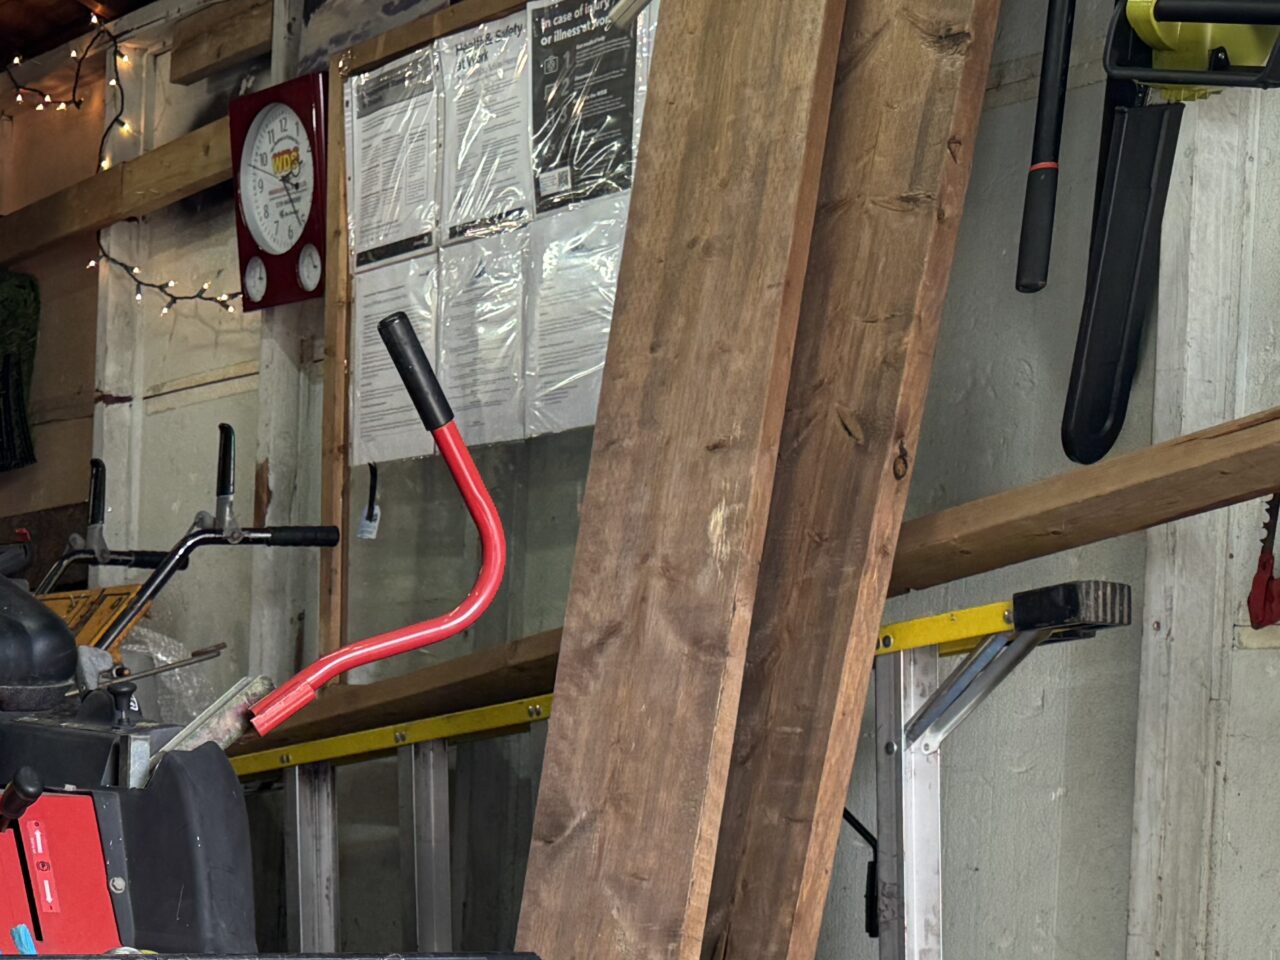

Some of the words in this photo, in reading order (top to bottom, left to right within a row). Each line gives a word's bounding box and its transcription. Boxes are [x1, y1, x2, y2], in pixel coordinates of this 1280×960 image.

[553, 12, 573, 26] case
[573, 3, 584, 18] of
[584, 0, 610, 15] injury
[454, 35, 485, 55] Health
[484, 32, 494, 46] &
[495, 22, 523, 42] Safety
[540, 36, 552, 46] or
[553, 25, 580, 43] illness
[456, 57, 466, 71] at
[469, 49, 489, 68] Work
[279, 116, 288, 133] 12
[295, 121, 300, 137] 1
[267, 128, 276, 145] 11
[259, 152, 269, 167] 10
[257, 179, 264, 194] 9
[263, 203, 270, 220] 8
[274, 220, 280, 237] 7
[287, 224, 294, 240] 6
